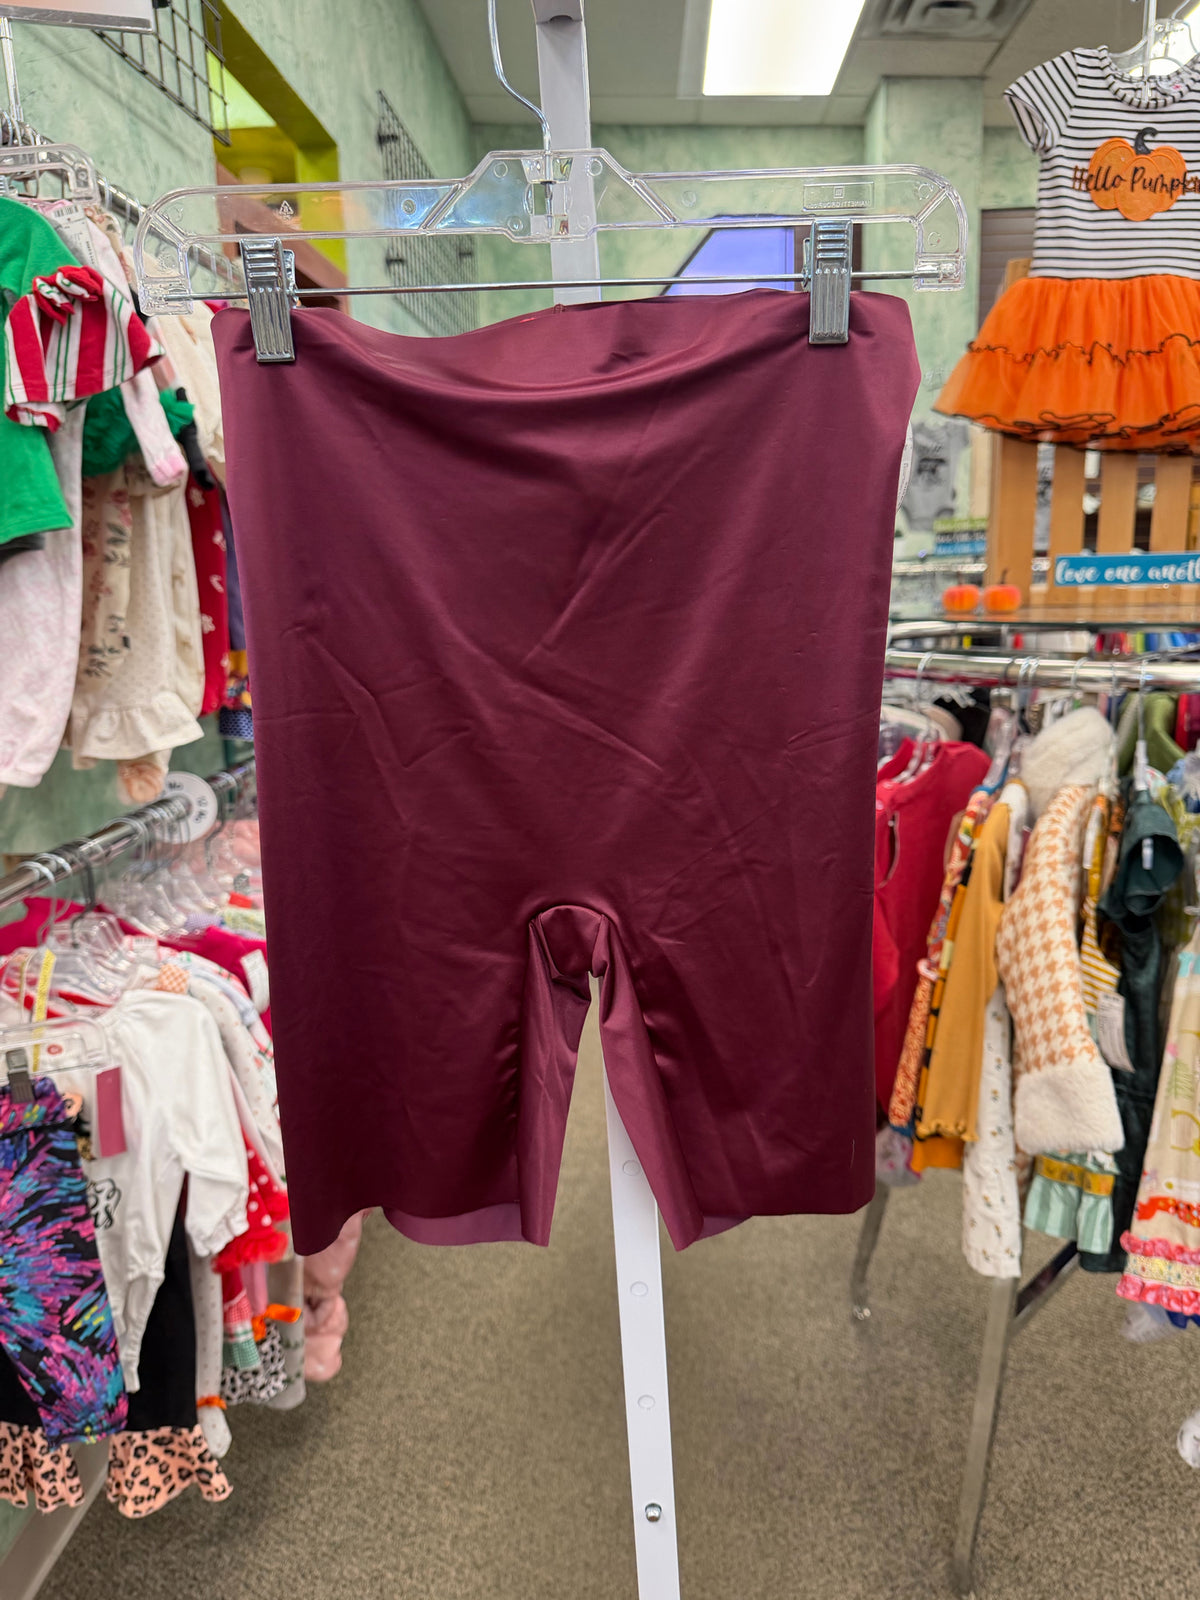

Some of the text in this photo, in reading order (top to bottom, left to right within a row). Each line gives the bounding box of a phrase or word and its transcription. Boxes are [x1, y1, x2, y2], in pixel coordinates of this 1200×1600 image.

[1072, 165, 1200, 199] Hello Pumpki
[1055, 559, 1099, 584] love
[1104, 565, 1143, 582] one
